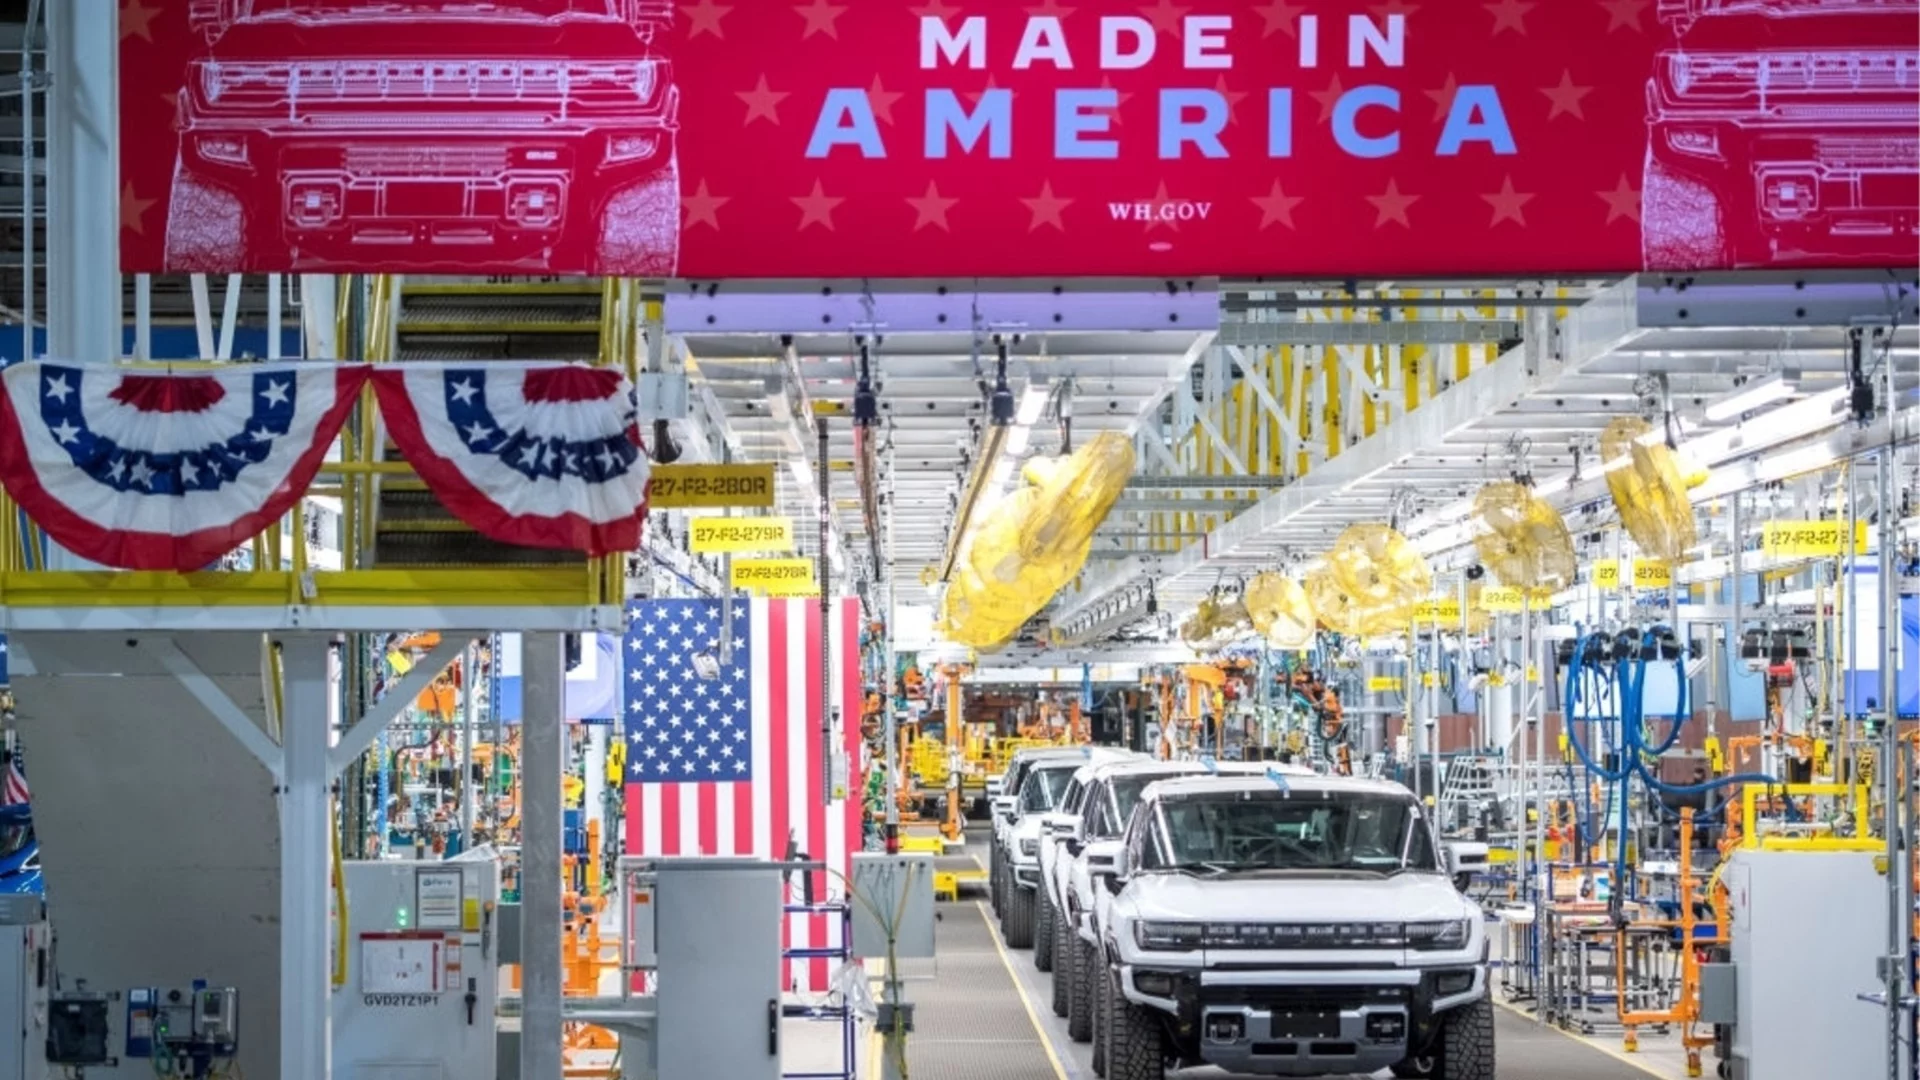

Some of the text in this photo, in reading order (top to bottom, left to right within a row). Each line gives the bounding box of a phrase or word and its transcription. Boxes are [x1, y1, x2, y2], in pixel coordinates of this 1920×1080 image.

[919, 14, 1406, 69] MADE IN
[804, 85, 1519, 159] AMERICA
[1108, 201, 1212, 221] WH.GOV
